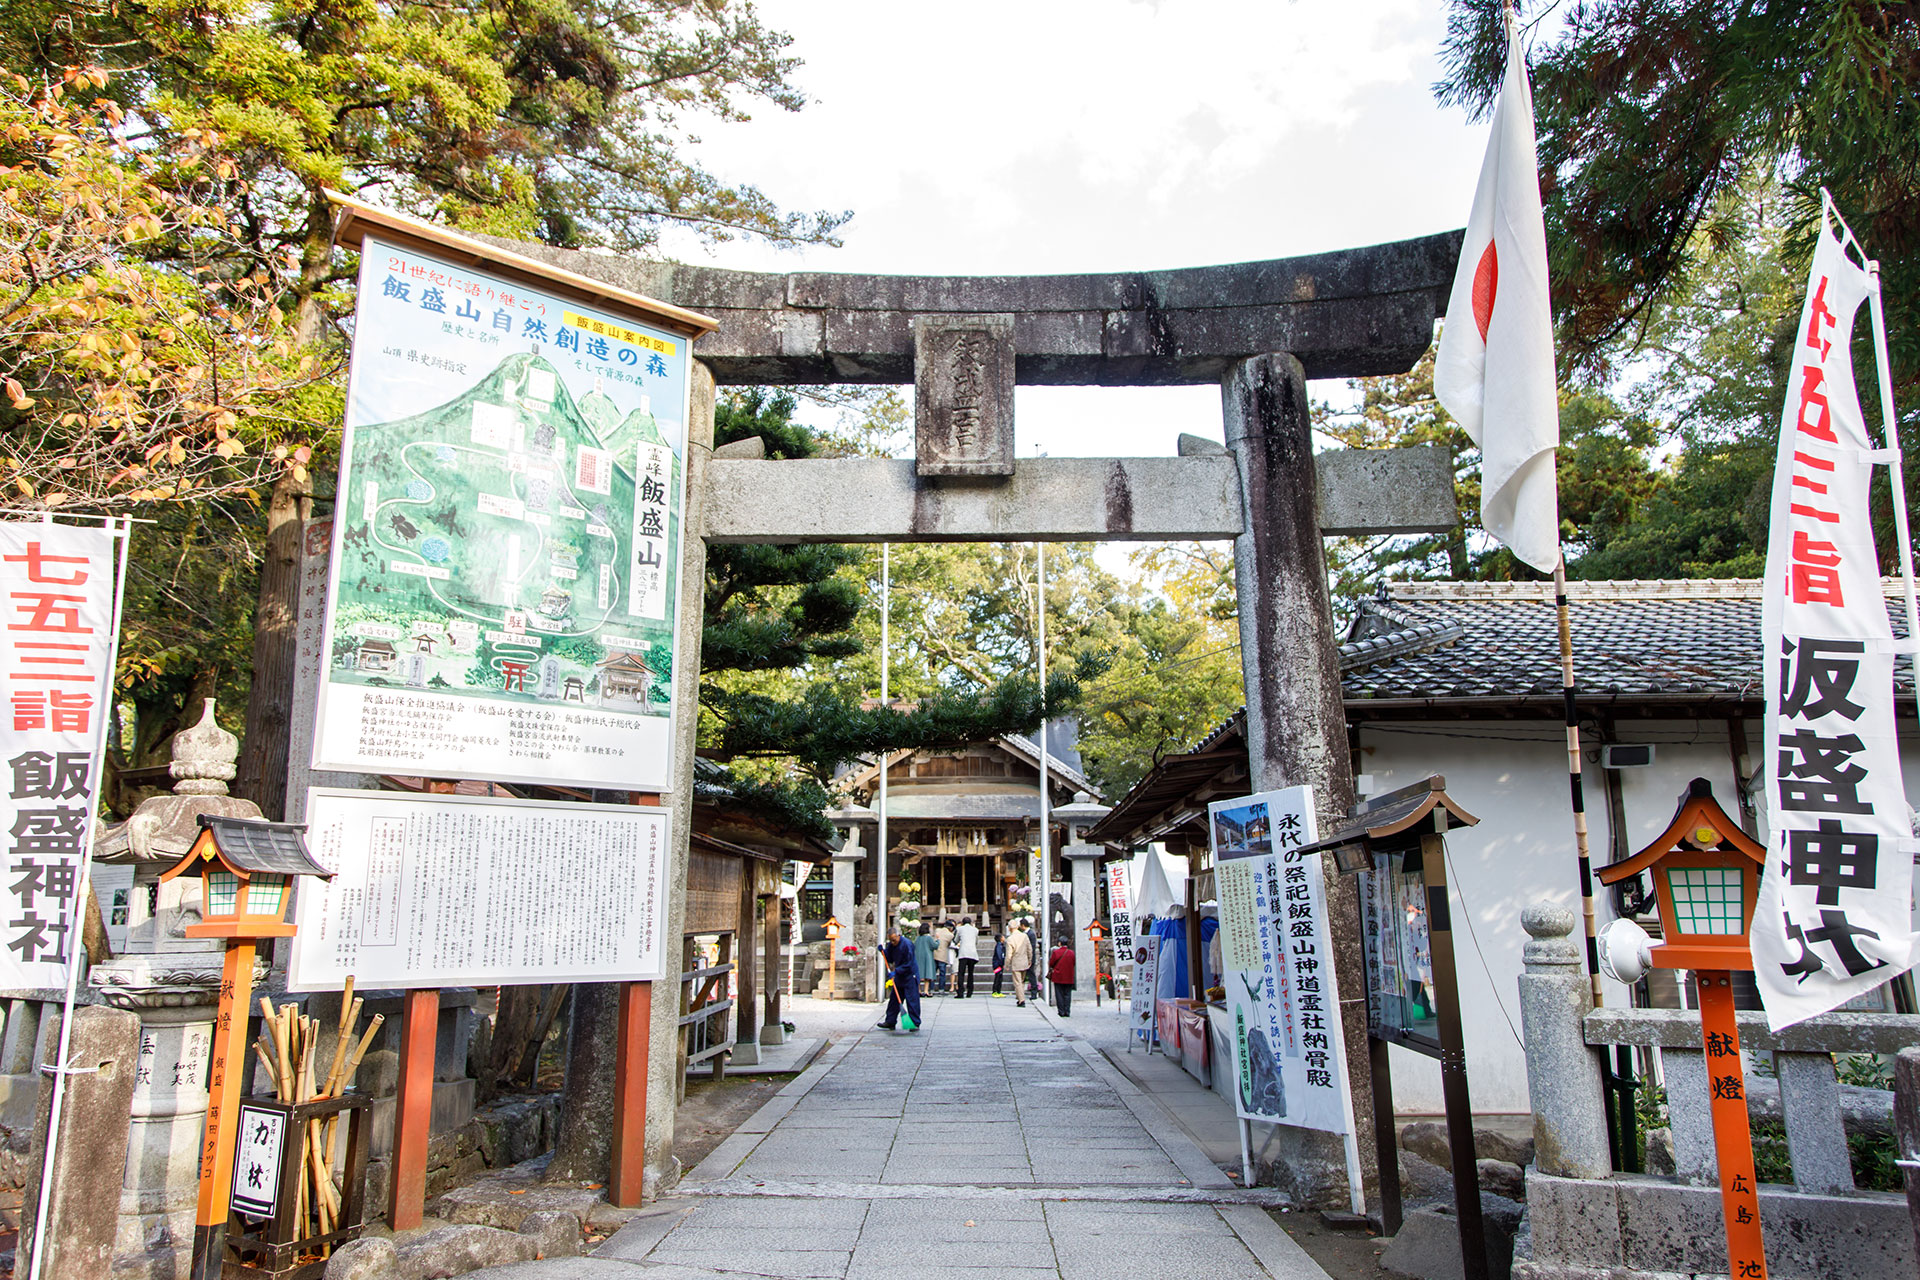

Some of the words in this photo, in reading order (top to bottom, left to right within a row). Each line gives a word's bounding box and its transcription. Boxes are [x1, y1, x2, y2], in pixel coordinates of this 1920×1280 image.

[381, 273, 669, 378] 飯盛山自然創造の森
[388, 256, 548, 317] 21世紀に語り継ごう
[440, 320, 500, 347] 歴史と名所
[576, 315, 666, 353] 飯盛山案内図
[637, 475, 666, 569] 飯盛山
[3, 541, 95, 734] 七五三詣
[8, 751, 92, 965] 飯盛神社
[1110, 867, 1127, 909] 七五三詣
[1113, 912, 1134, 961] 飯盛神社
[1277, 812, 1334, 1089] 永代の祭祀飯盛山神道霊社納骨殿
[1706, 1031, 1744, 1101] 献燈
[1731, 1174, 1754, 1226] 広島
